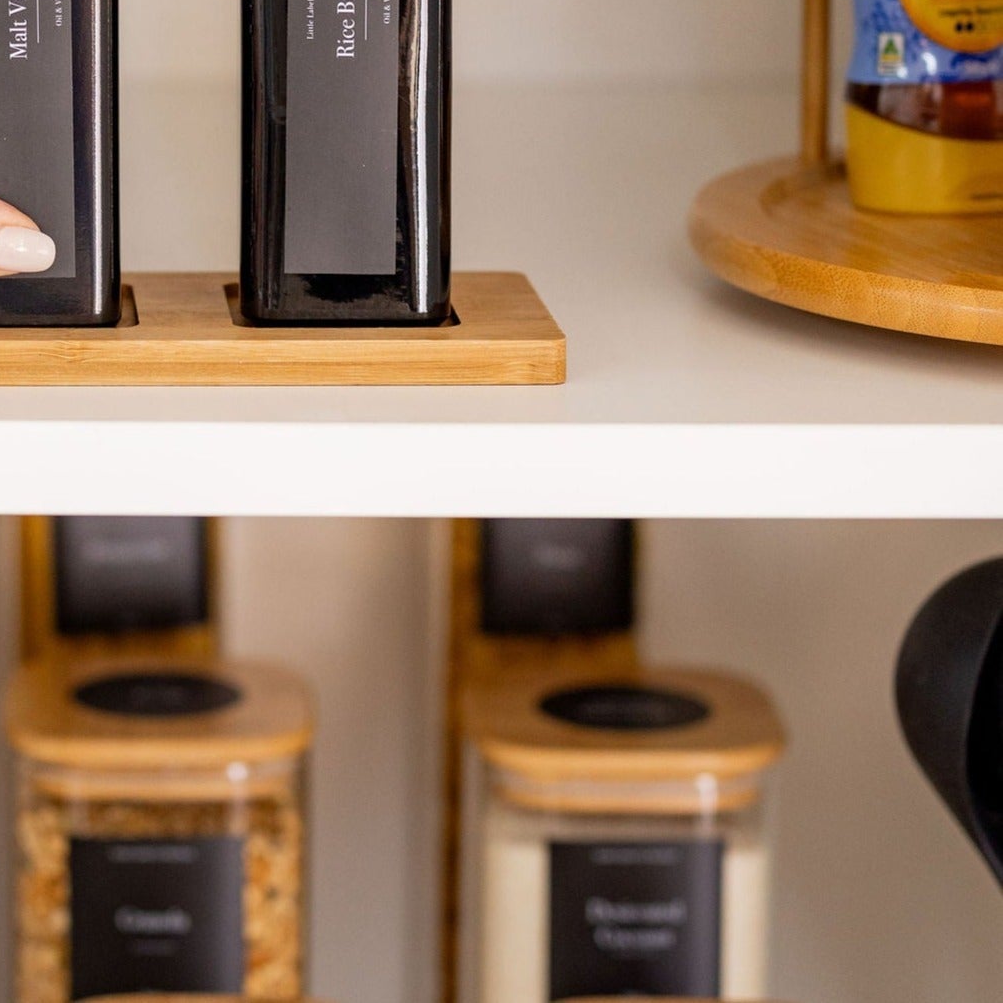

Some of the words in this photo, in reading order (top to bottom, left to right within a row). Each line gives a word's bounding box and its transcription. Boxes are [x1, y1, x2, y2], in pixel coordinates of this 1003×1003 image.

[55, 15, 63, 27] Oil
[383, 12, 391, 24] Oil
[9, 19, 28, 60] Malt
[306, 20, 314, 40] Little
[336, 19, 355, 58] Rice
